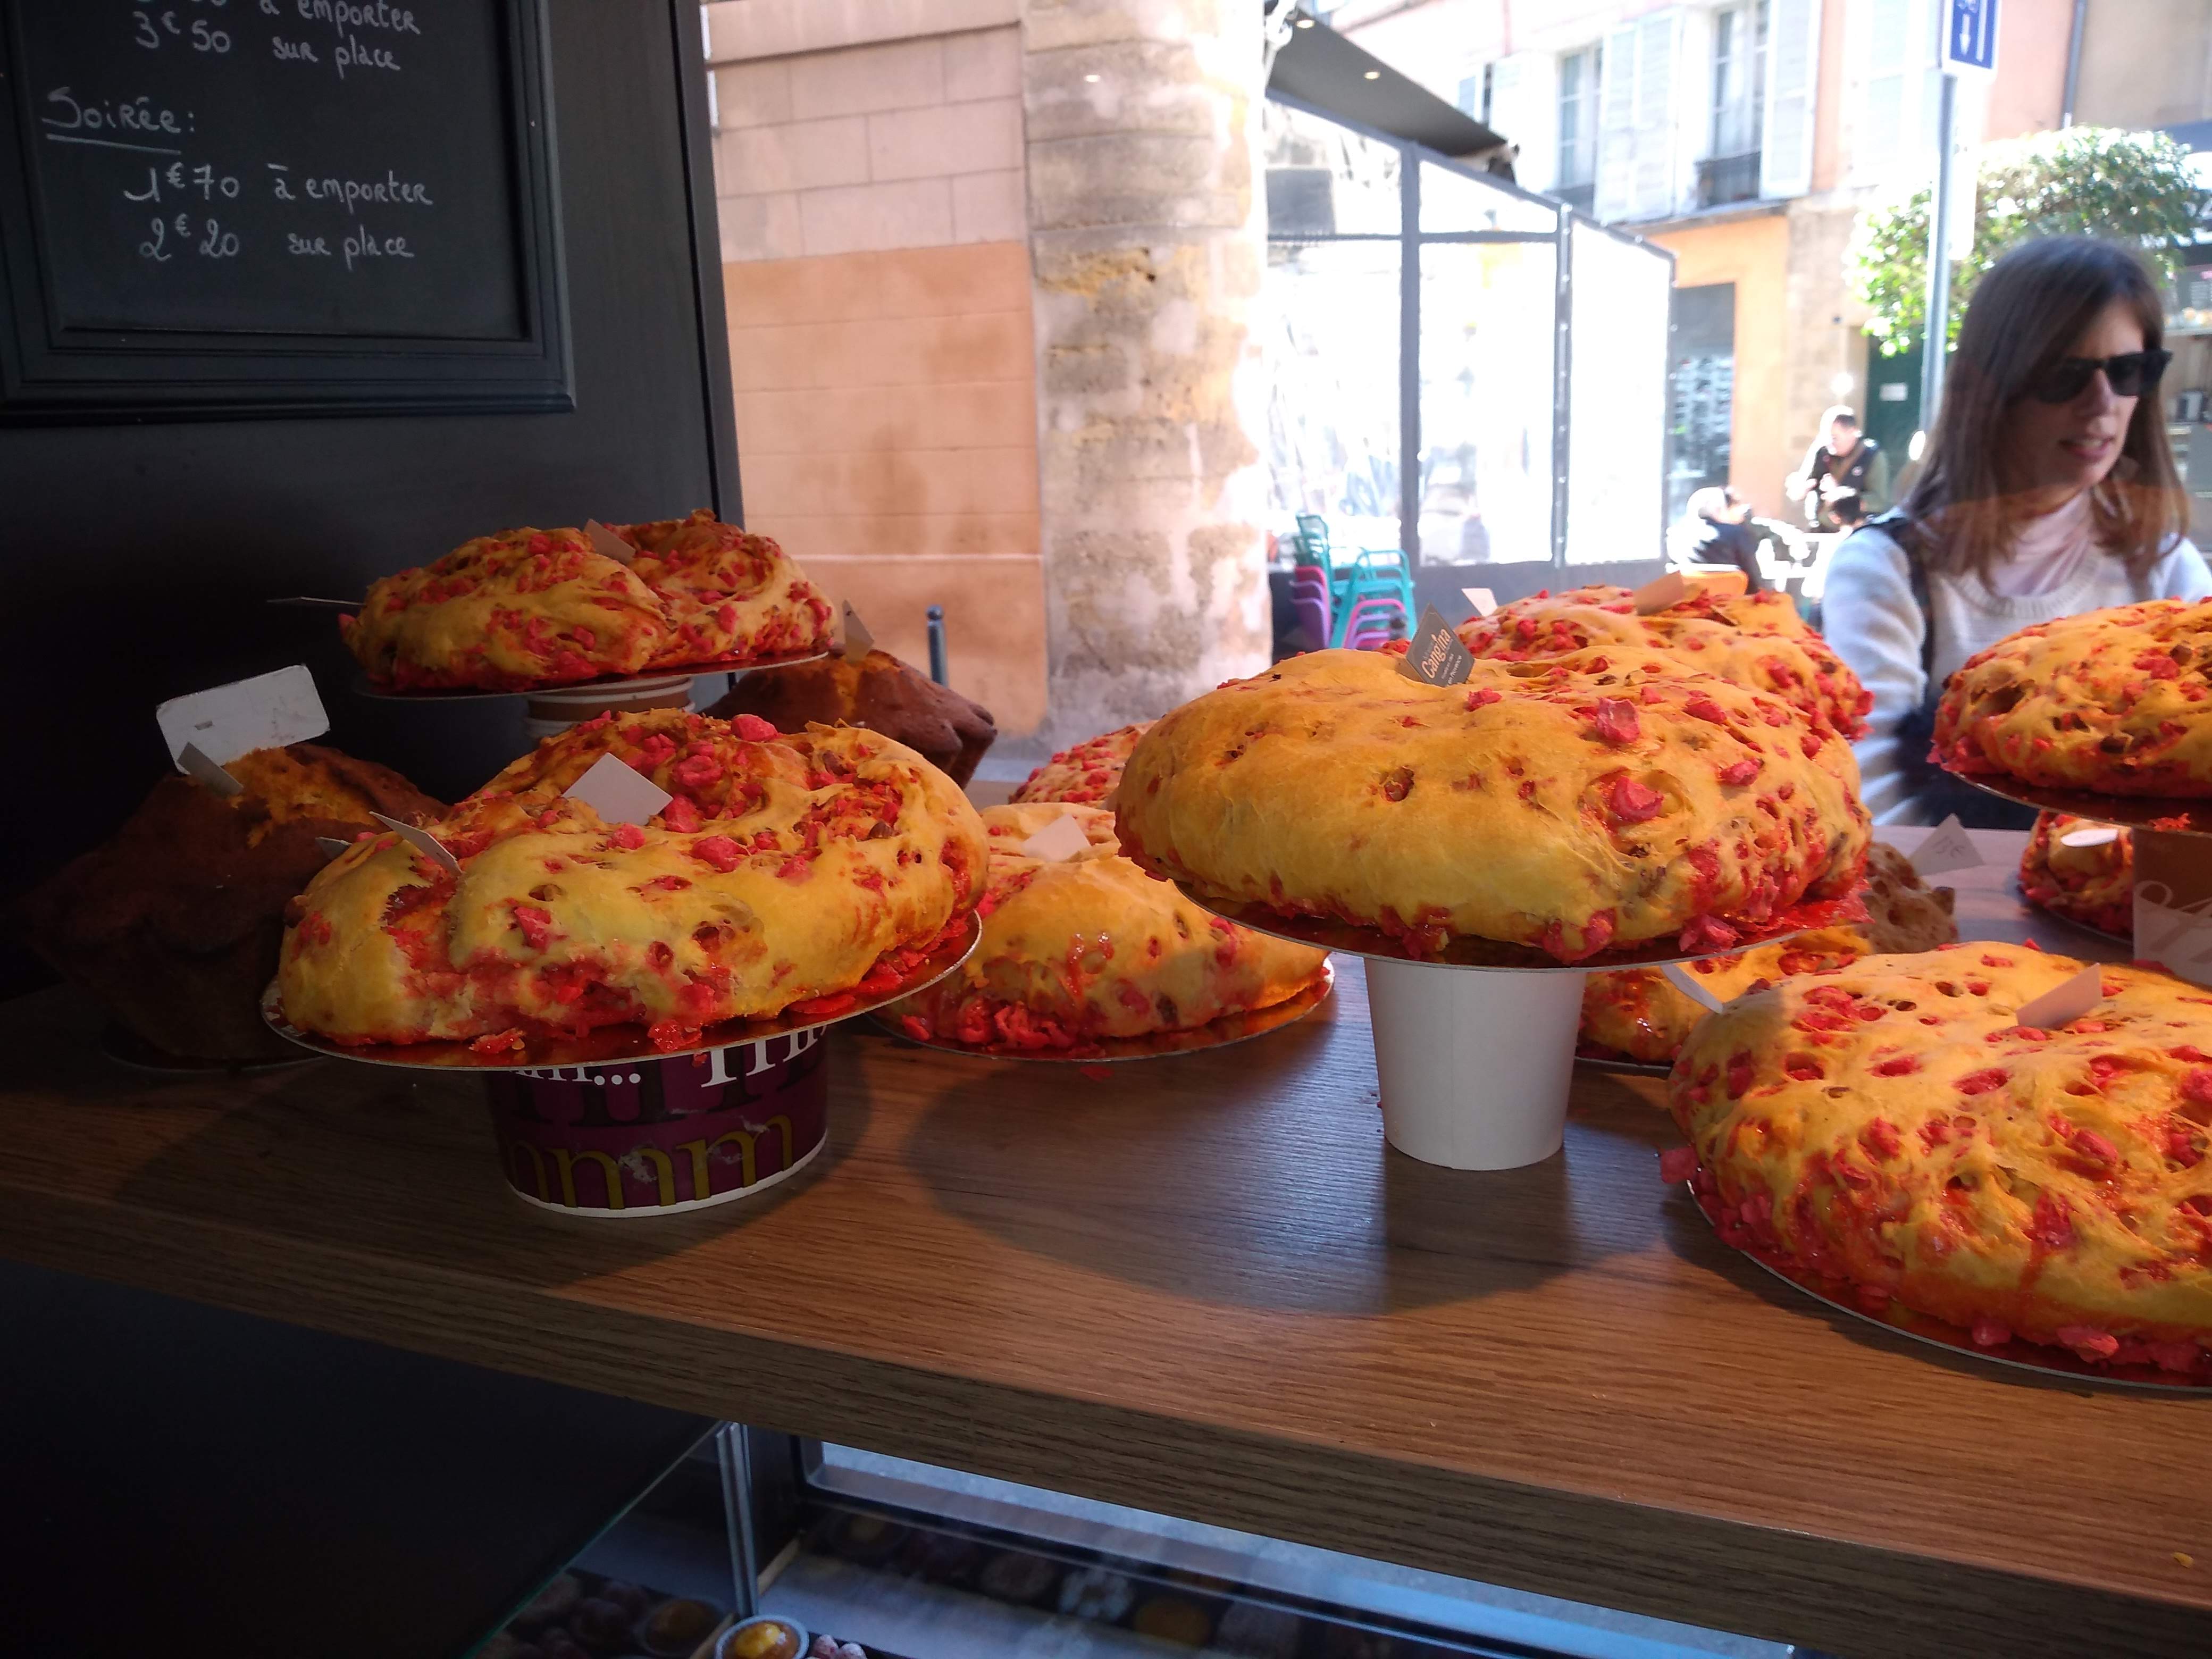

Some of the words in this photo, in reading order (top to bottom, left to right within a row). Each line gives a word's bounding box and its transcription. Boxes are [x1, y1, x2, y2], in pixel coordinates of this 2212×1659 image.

[335, 34, 401, 79] place
[343, 225, 415, 270] place
[1421, 629, 1451, 679] Cangina
